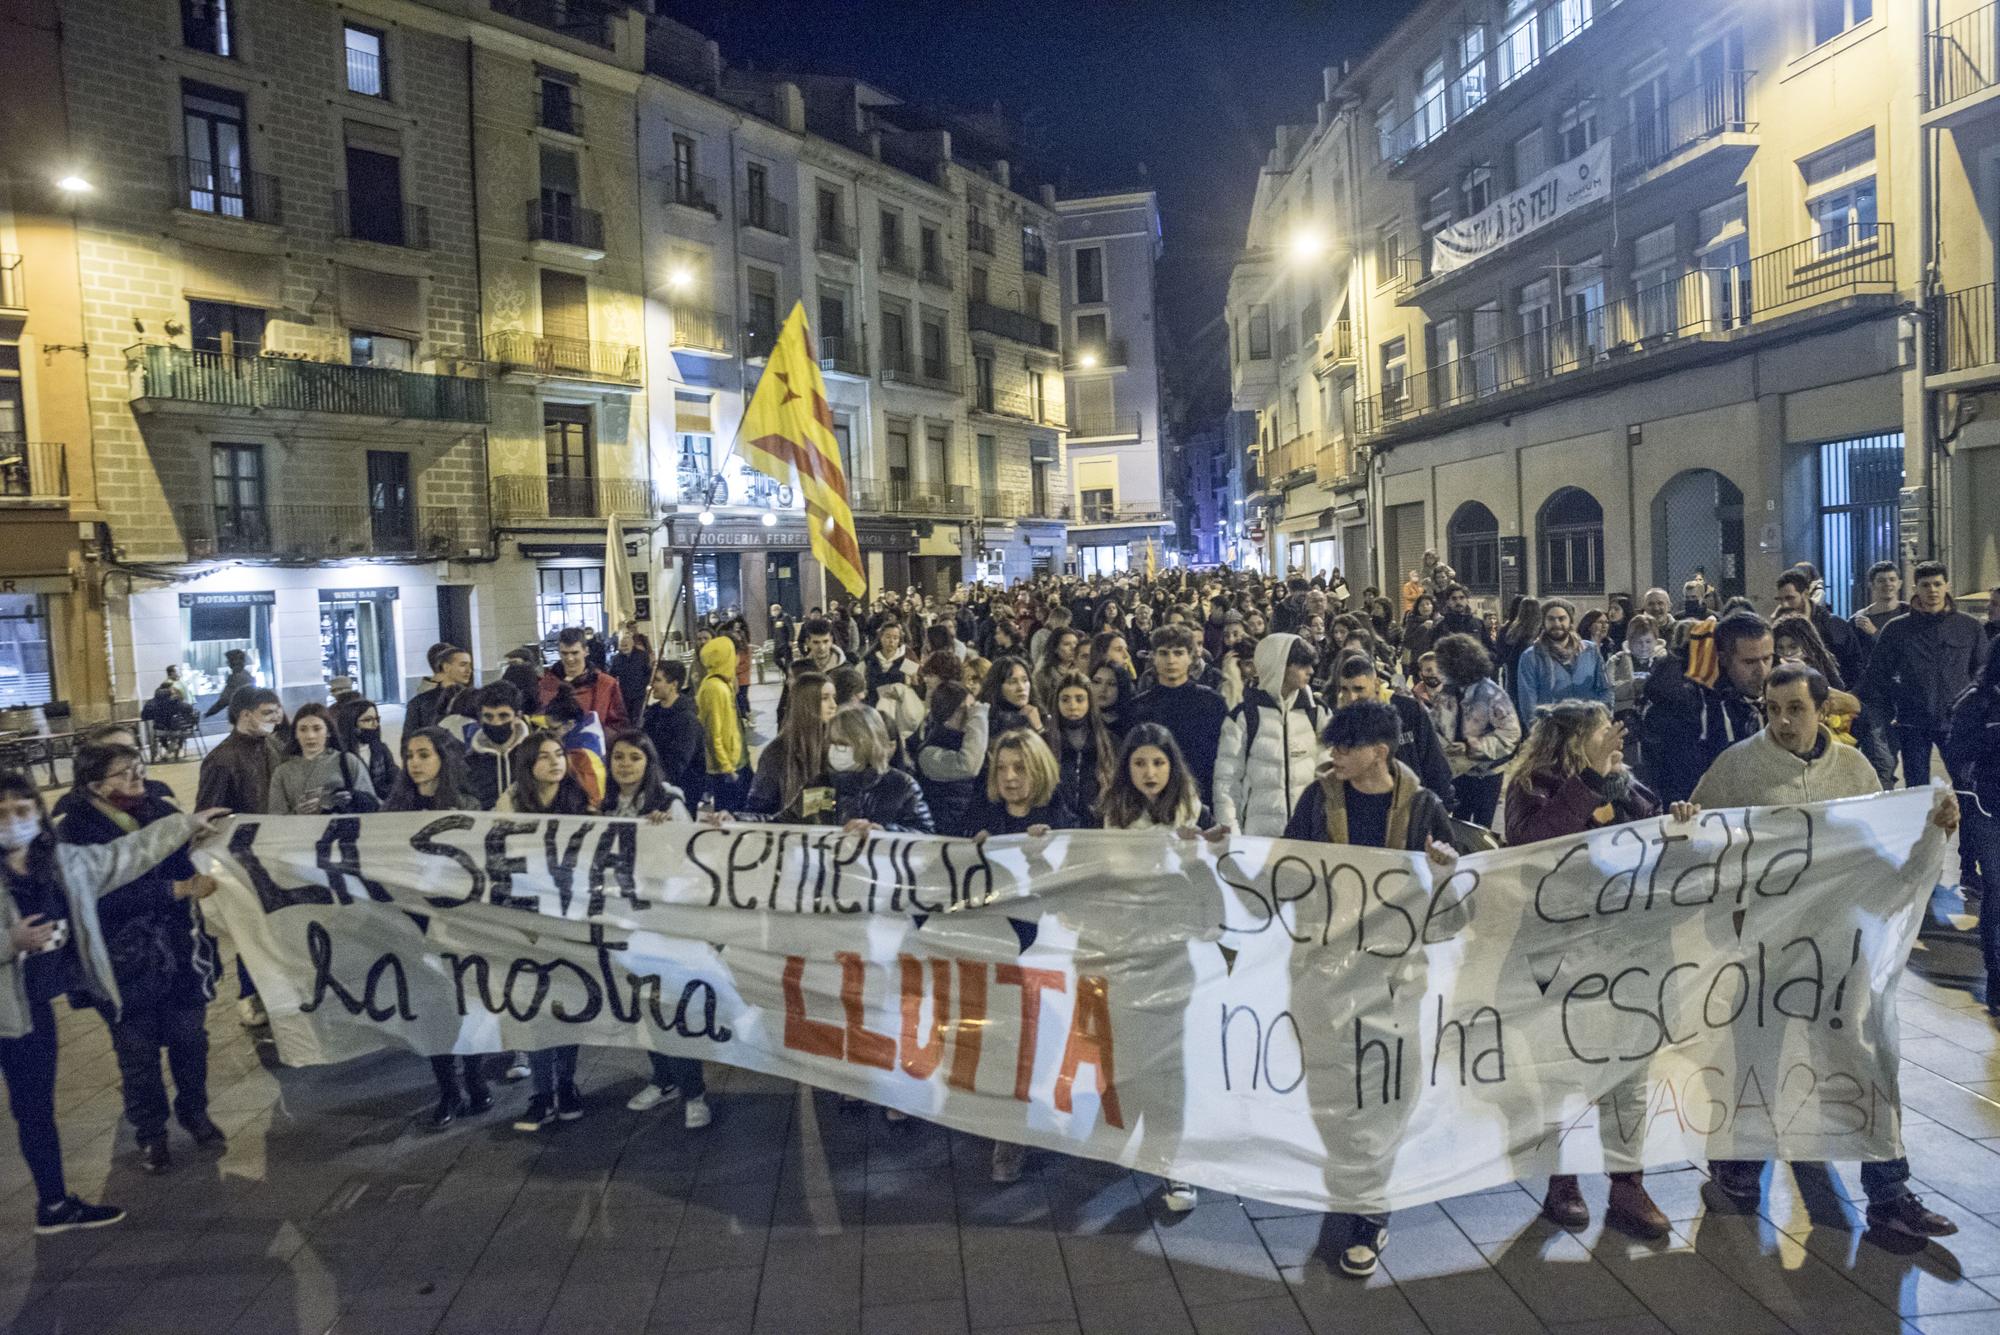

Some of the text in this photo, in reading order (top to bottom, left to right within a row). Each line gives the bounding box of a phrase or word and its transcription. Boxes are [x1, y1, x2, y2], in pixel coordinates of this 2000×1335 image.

[1530, 178, 1558, 226] TEU
[197, 595, 236, 604] BOTIGA
[238, 594, 251, 602] DE
[334, 590, 376, 599] WINE BAR
[227, 816, 394, 914] LA
[410, 813, 651, 917] SEVA
[1216, 850, 1480, 958] sense
[441, 918, 731, 1043] nostra
[783, 951, 1124, 1129] LLUITA
[1221, 928, 1863, 1110] no hi ha escola!
